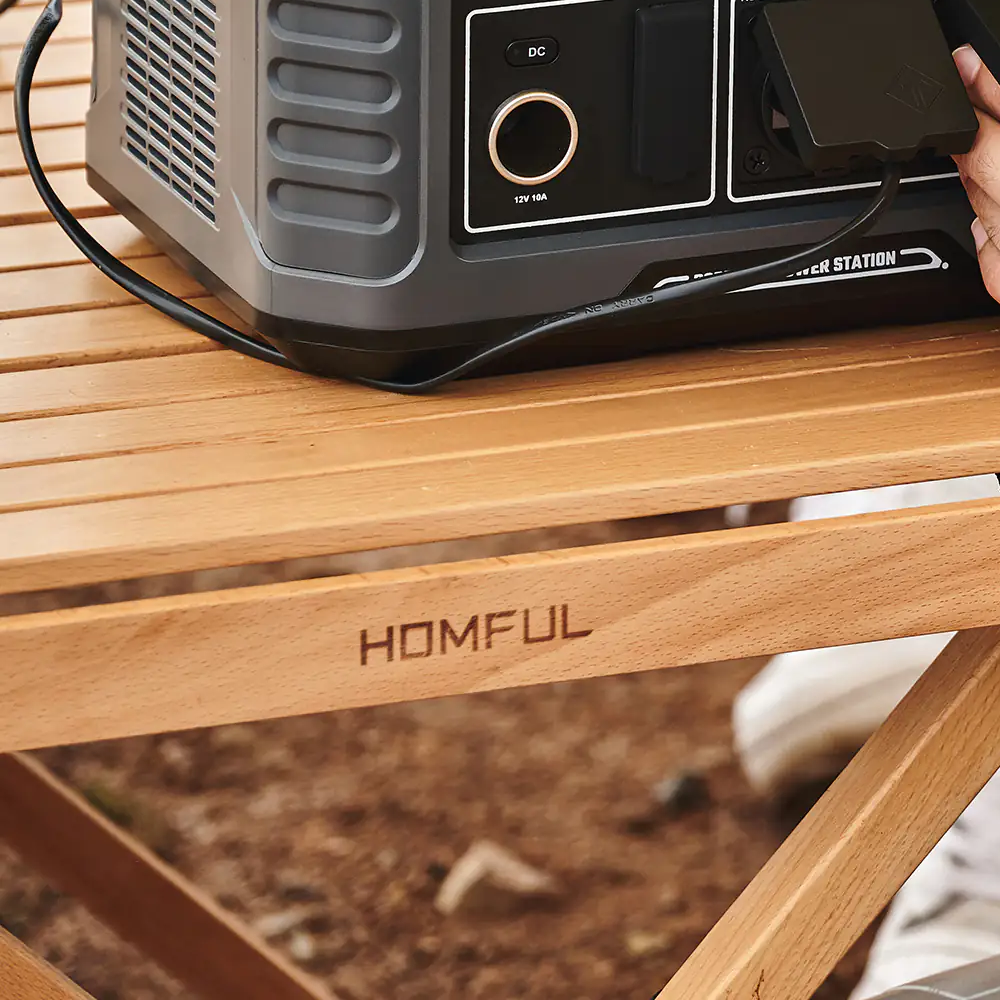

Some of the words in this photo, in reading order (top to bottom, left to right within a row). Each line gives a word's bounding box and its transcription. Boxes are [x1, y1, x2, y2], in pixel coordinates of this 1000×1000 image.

[527, 45, 546, 59] DC
[513, 194, 530, 204] 12V
[531, 192, 548, 202] 10A
[832, 249, 897, 273] STATION
[359, 603, 594, 667] HOMFUL
